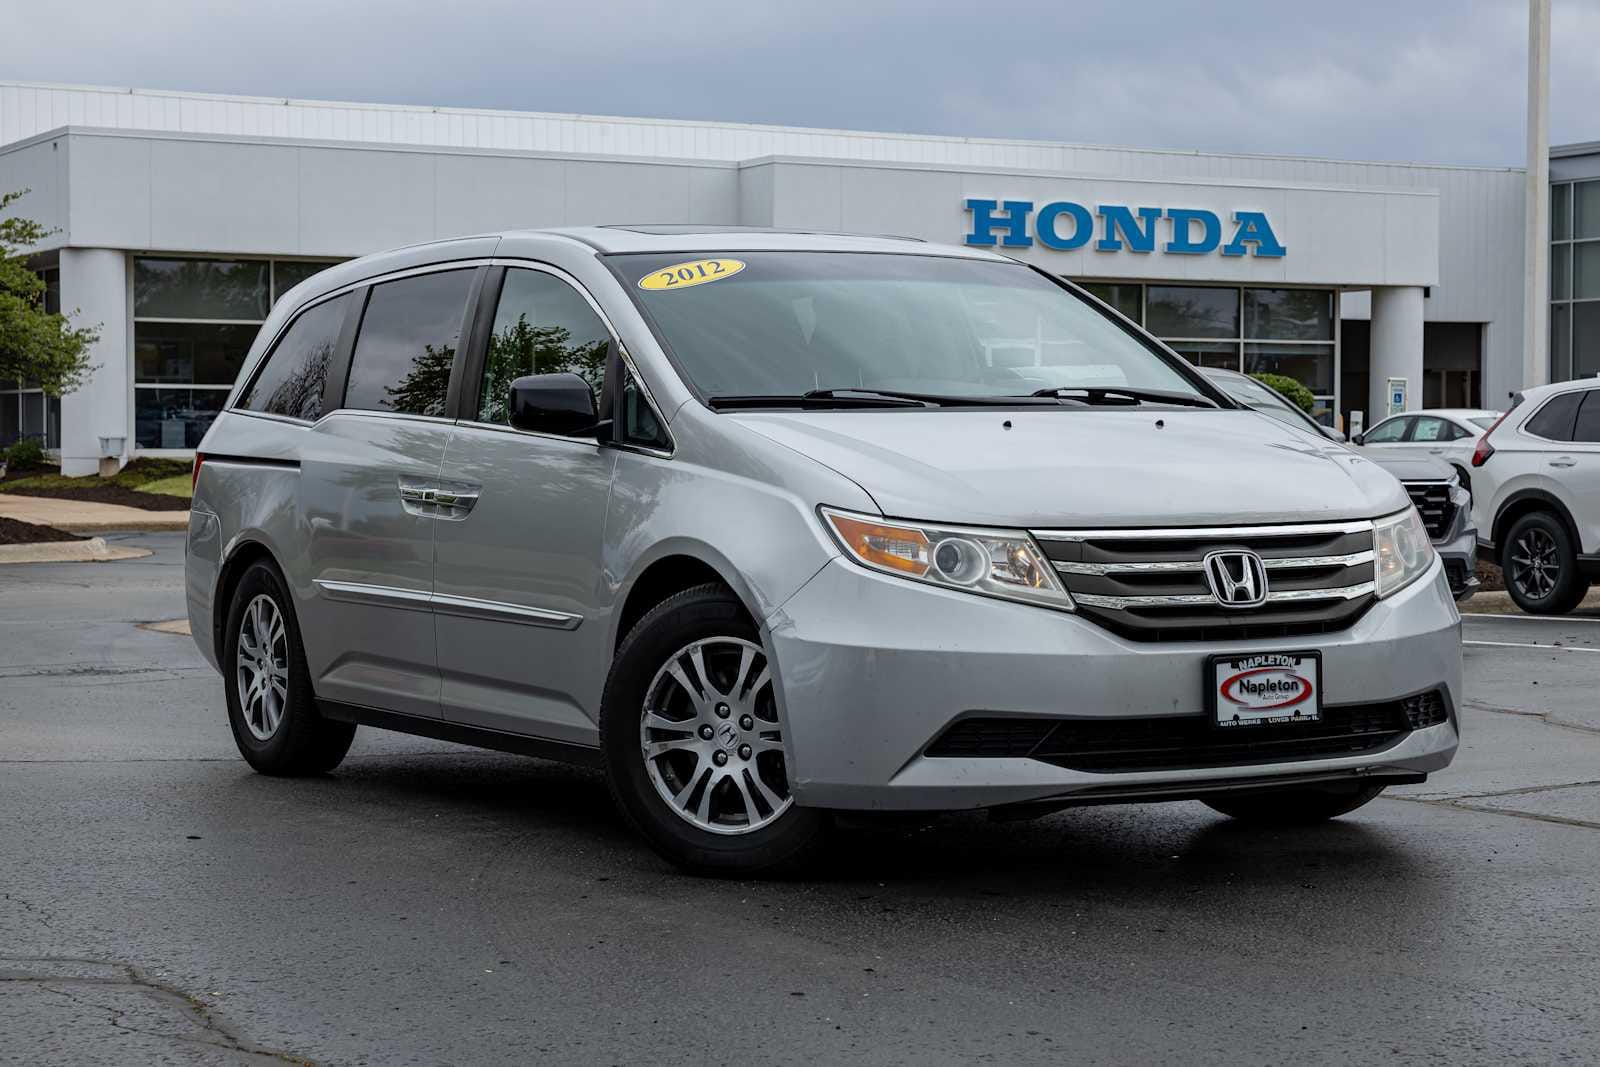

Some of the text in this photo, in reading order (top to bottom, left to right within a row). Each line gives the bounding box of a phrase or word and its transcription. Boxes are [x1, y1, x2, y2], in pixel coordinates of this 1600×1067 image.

[964, 199, 1287, 257] HONDA
[660, 261, 725, 286] 2012
[1238, 655, 1296, 671] NAPLETON
[1239, 678, 1299, 695] Napleton
